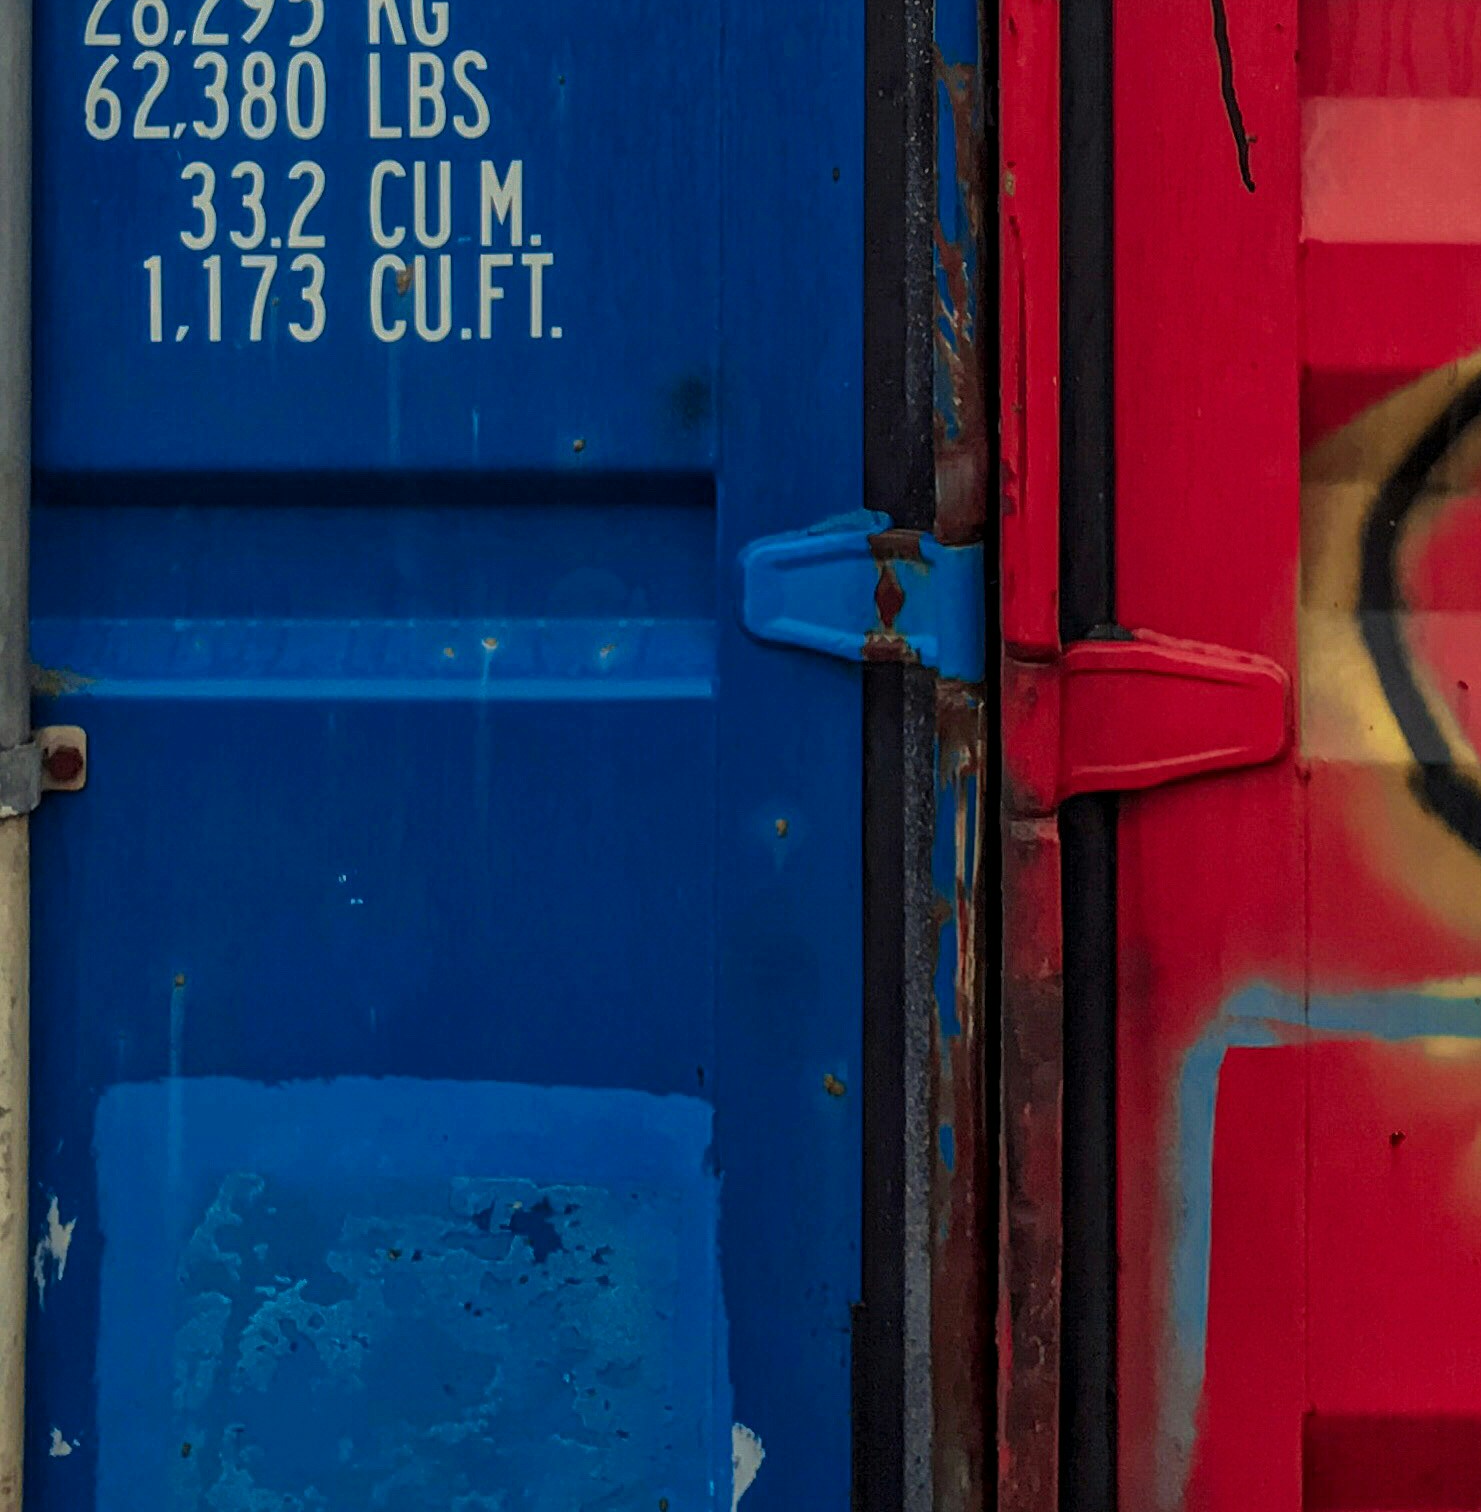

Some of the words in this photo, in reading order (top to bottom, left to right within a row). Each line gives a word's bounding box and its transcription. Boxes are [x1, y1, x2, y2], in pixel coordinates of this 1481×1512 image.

[86, 51, 324, 139] 62,380
[370, 51, 489, 137] LBS
[181, 162, 324, 249] 33.2
[370, 161, 450, 248] CU
[482, 161, 540, 246] M.
[144, 254, 325, 341] 1,173
